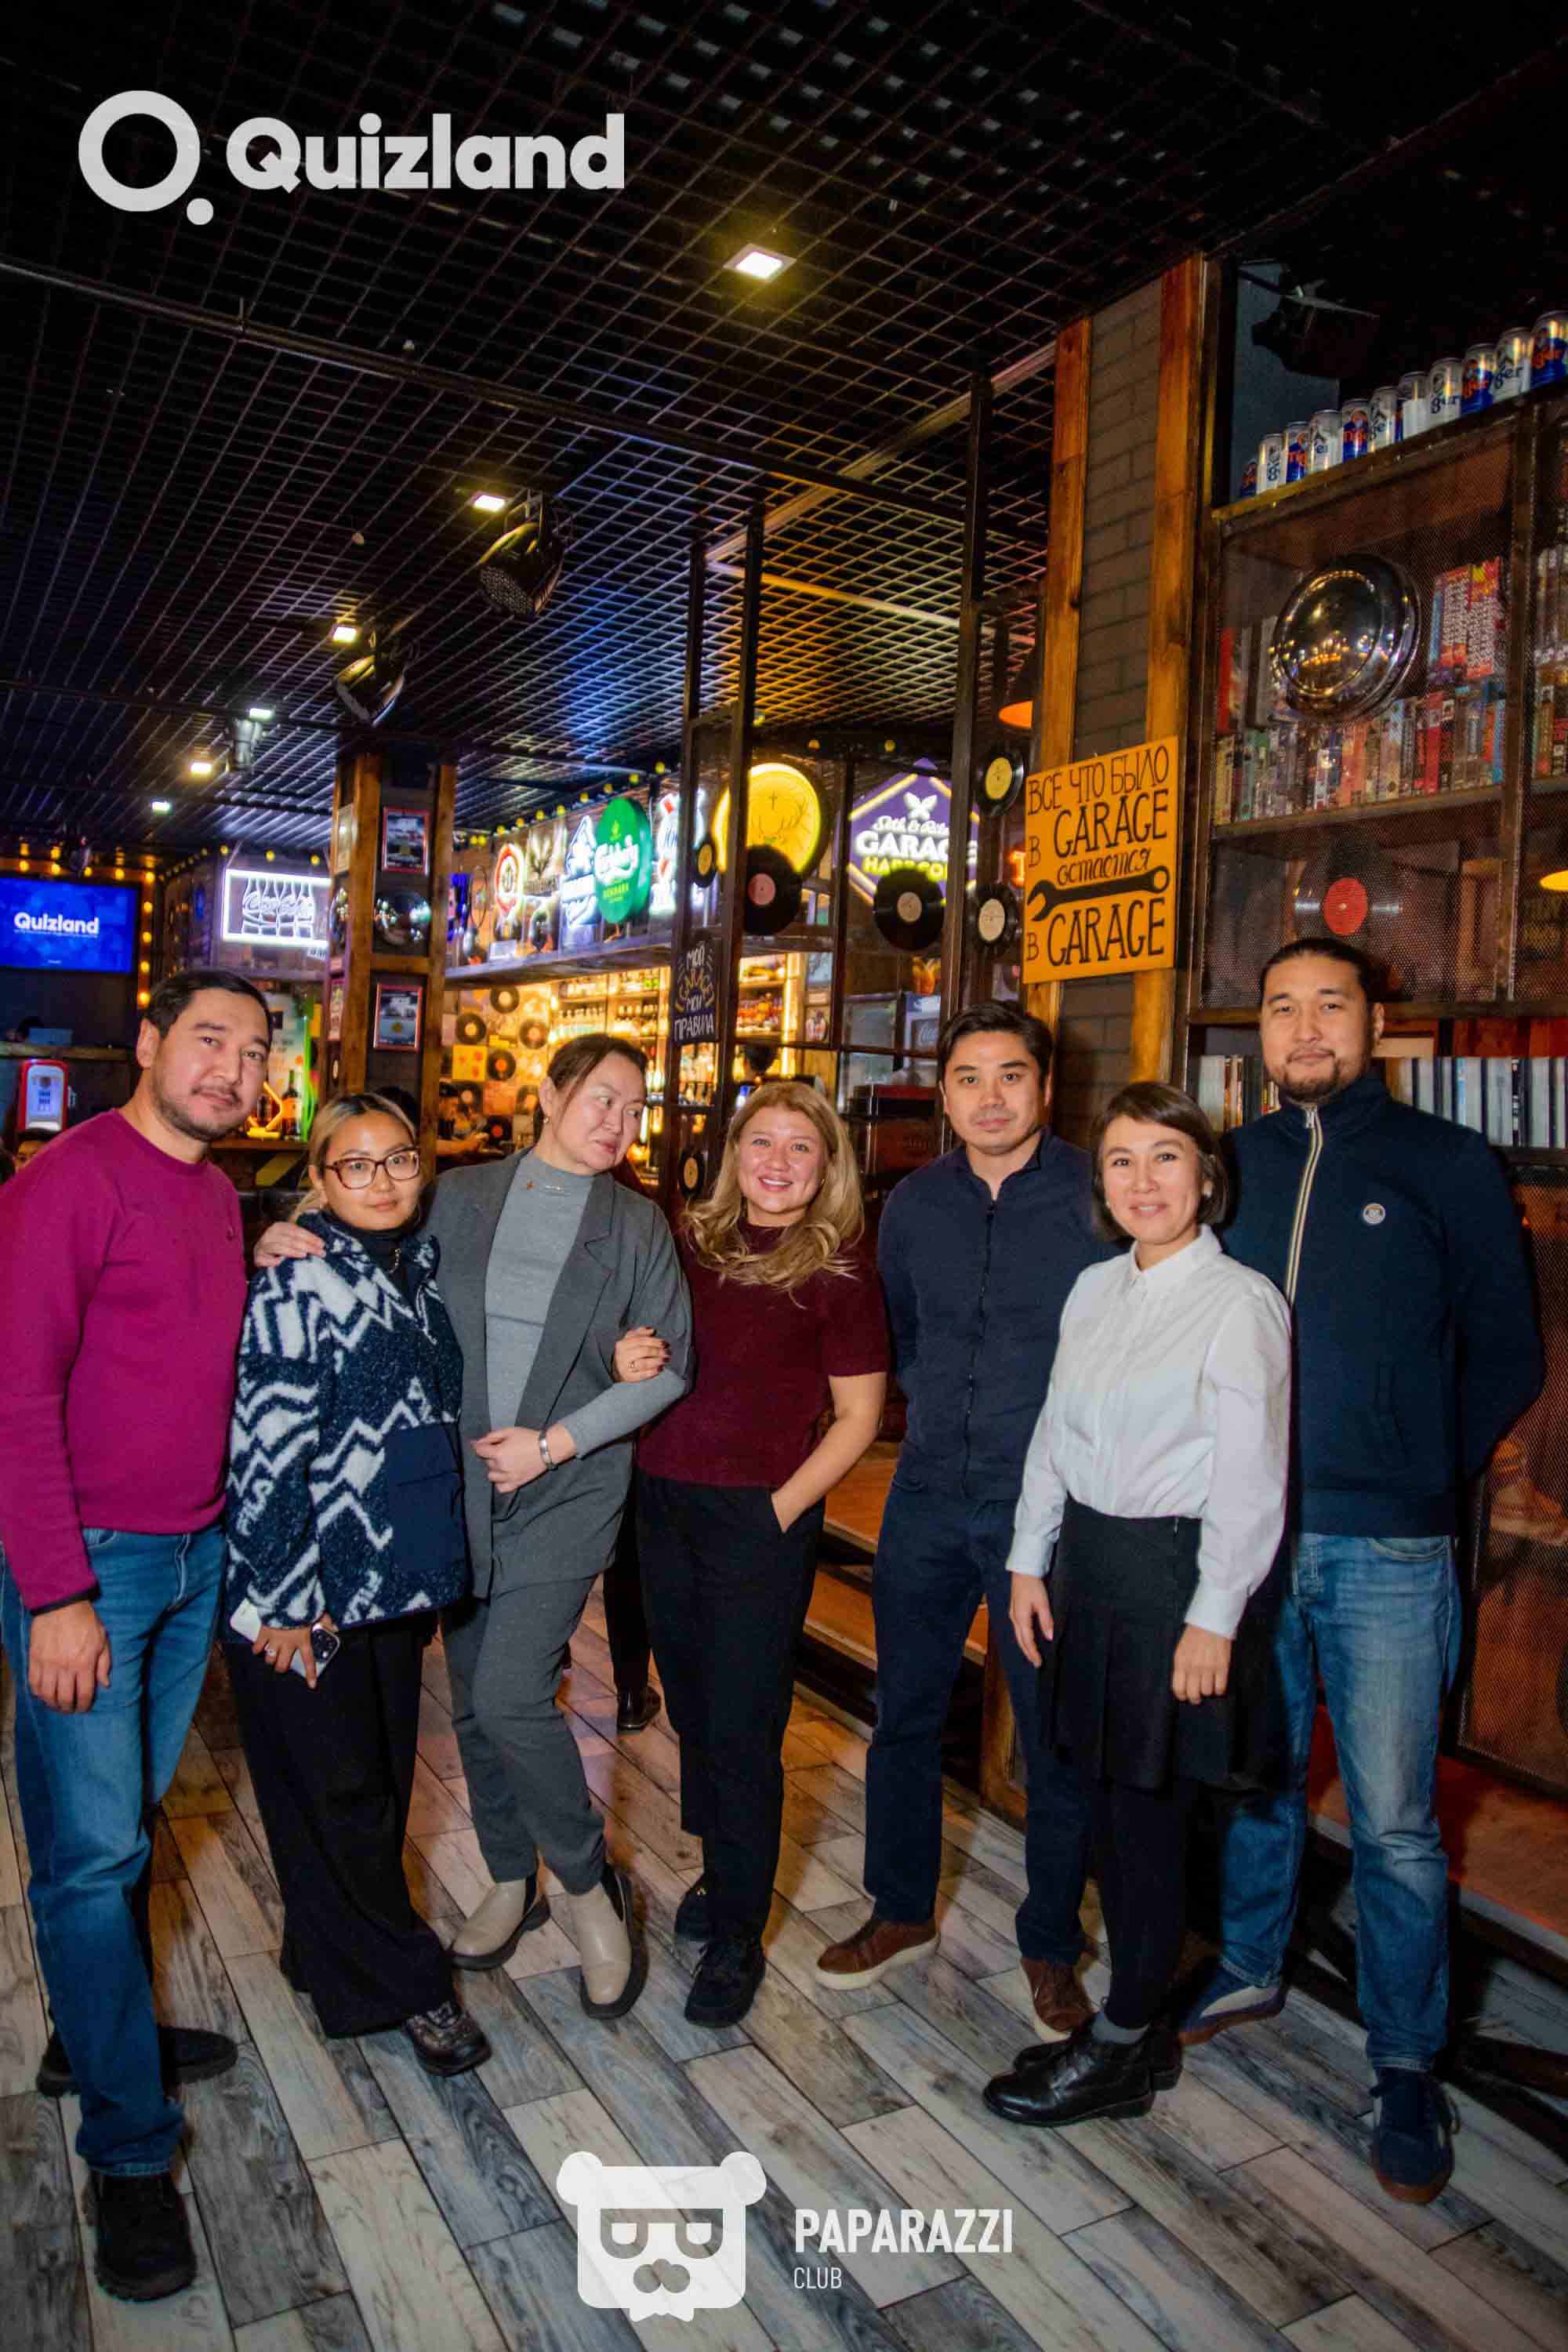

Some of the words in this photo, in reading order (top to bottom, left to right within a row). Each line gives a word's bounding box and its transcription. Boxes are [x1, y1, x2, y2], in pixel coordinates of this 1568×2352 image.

[1028, 772, 1062, 815] ВСЕ
[1069, 762, 1105, 804] ЧТО
[1111, 746, 1169, 795] БЫЛО
[1028, 835, 1041, 868] В
[1054, 789, 1168, 858] GARAGE
[13, 912, 100, 935] Quizland
[1025, 932, 1040, 962] В
[1047, 897, 1165, 967] GARAGE
